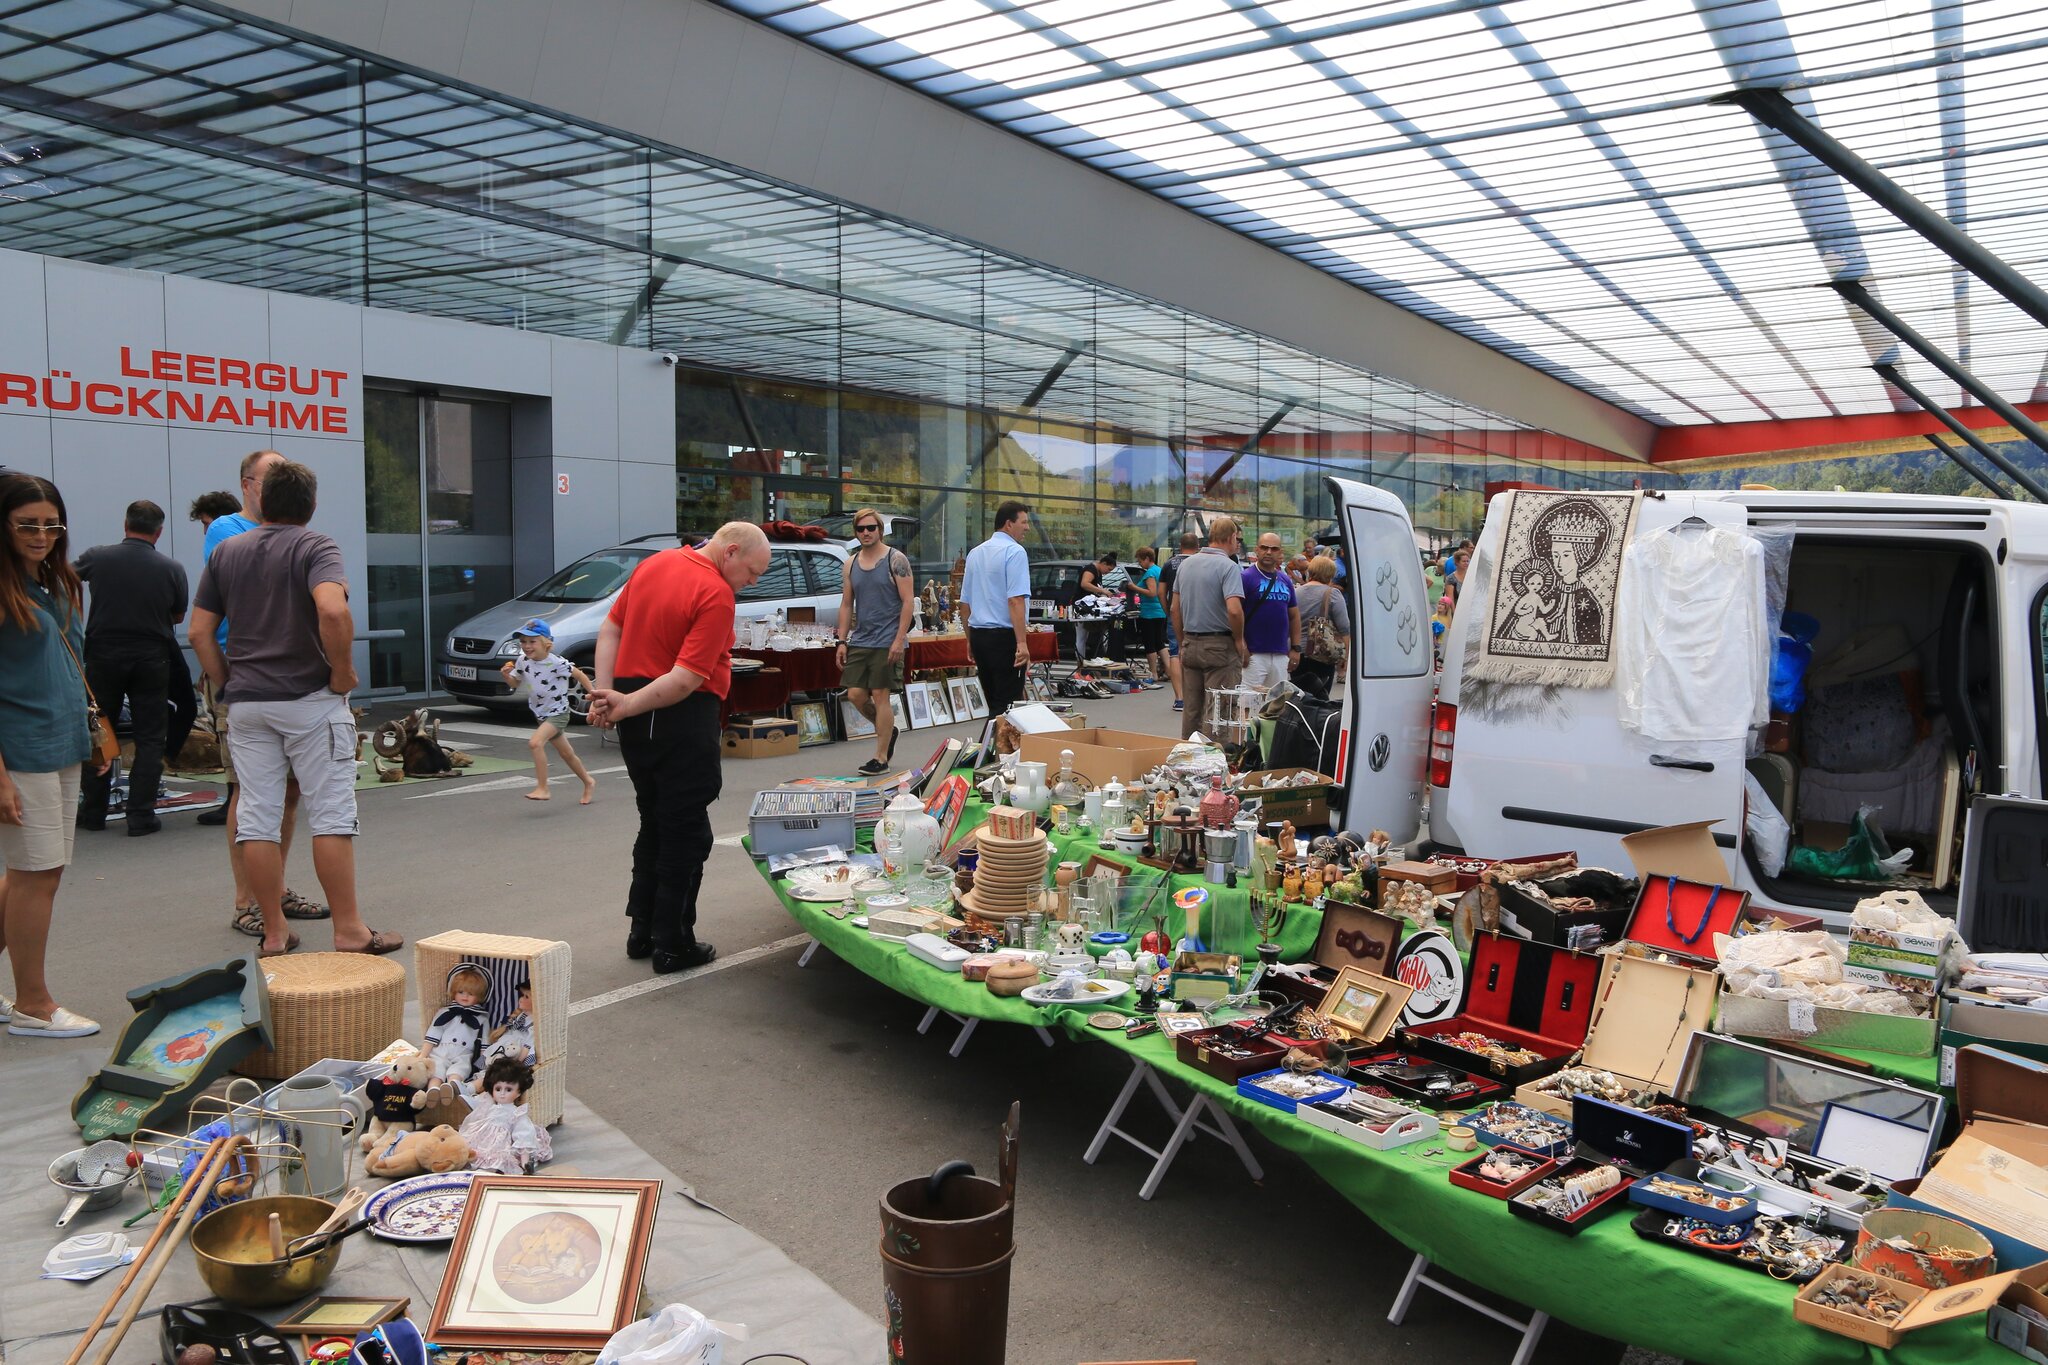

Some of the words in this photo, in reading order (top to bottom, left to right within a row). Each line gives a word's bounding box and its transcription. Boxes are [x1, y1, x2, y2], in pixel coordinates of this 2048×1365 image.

[121, 346, 348, 398] LEERGUT
[0, 370, 348, 434] RÜCKNAHME
[558, 475, 569, 493] 3
[1493, 640, 1543, 654] MARIA
